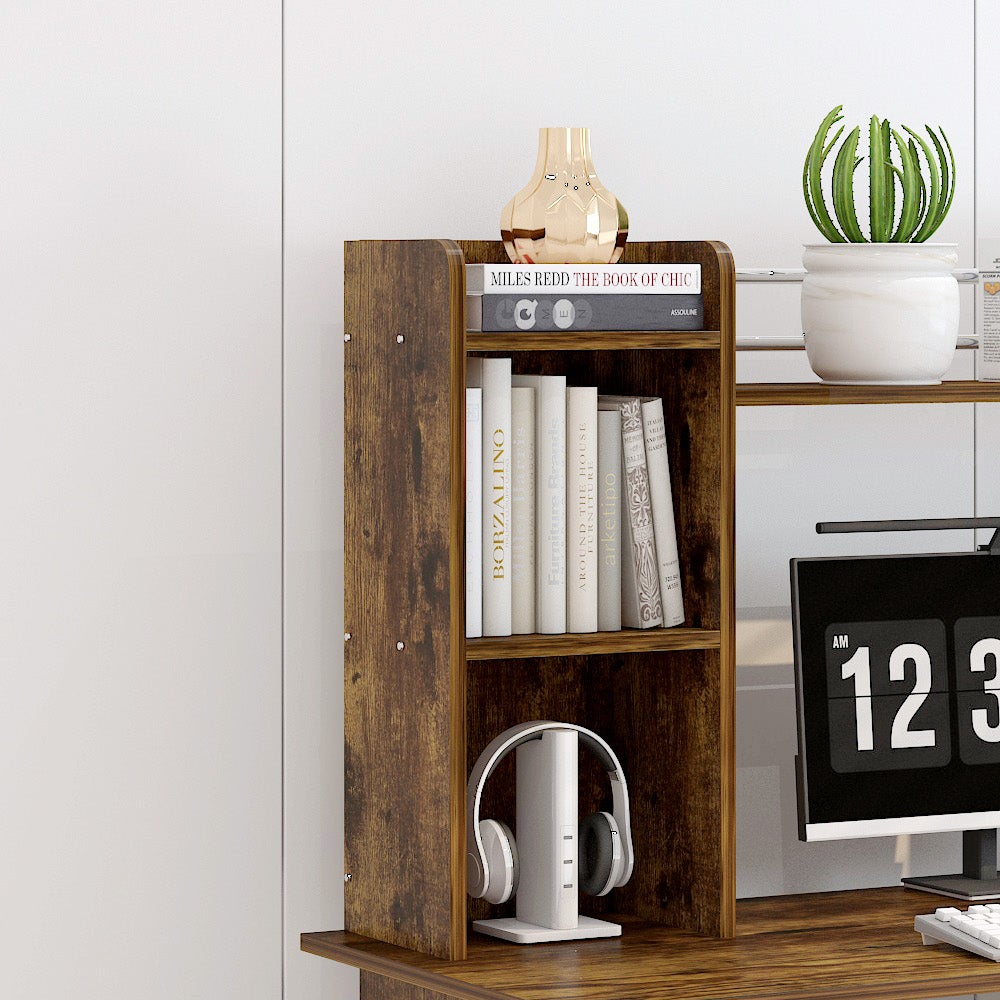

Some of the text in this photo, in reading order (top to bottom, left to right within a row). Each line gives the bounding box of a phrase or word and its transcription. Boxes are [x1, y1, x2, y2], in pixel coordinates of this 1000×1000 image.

[491, 272, 692, 287] MILES REDD THE BOOK OF CHIC
[670, 308, 698, 316] ASSOULINE
[492, 428, 505, 581] BORZALINO
[547, 418, 560, 586] Furniture Brands
[578, 422, 586, 592] AROUND THE HOUSE
[601, 472, 619, 567] arketipo
[832, 634, 849, 650] AM
[840, 642, 936, 751] 12
